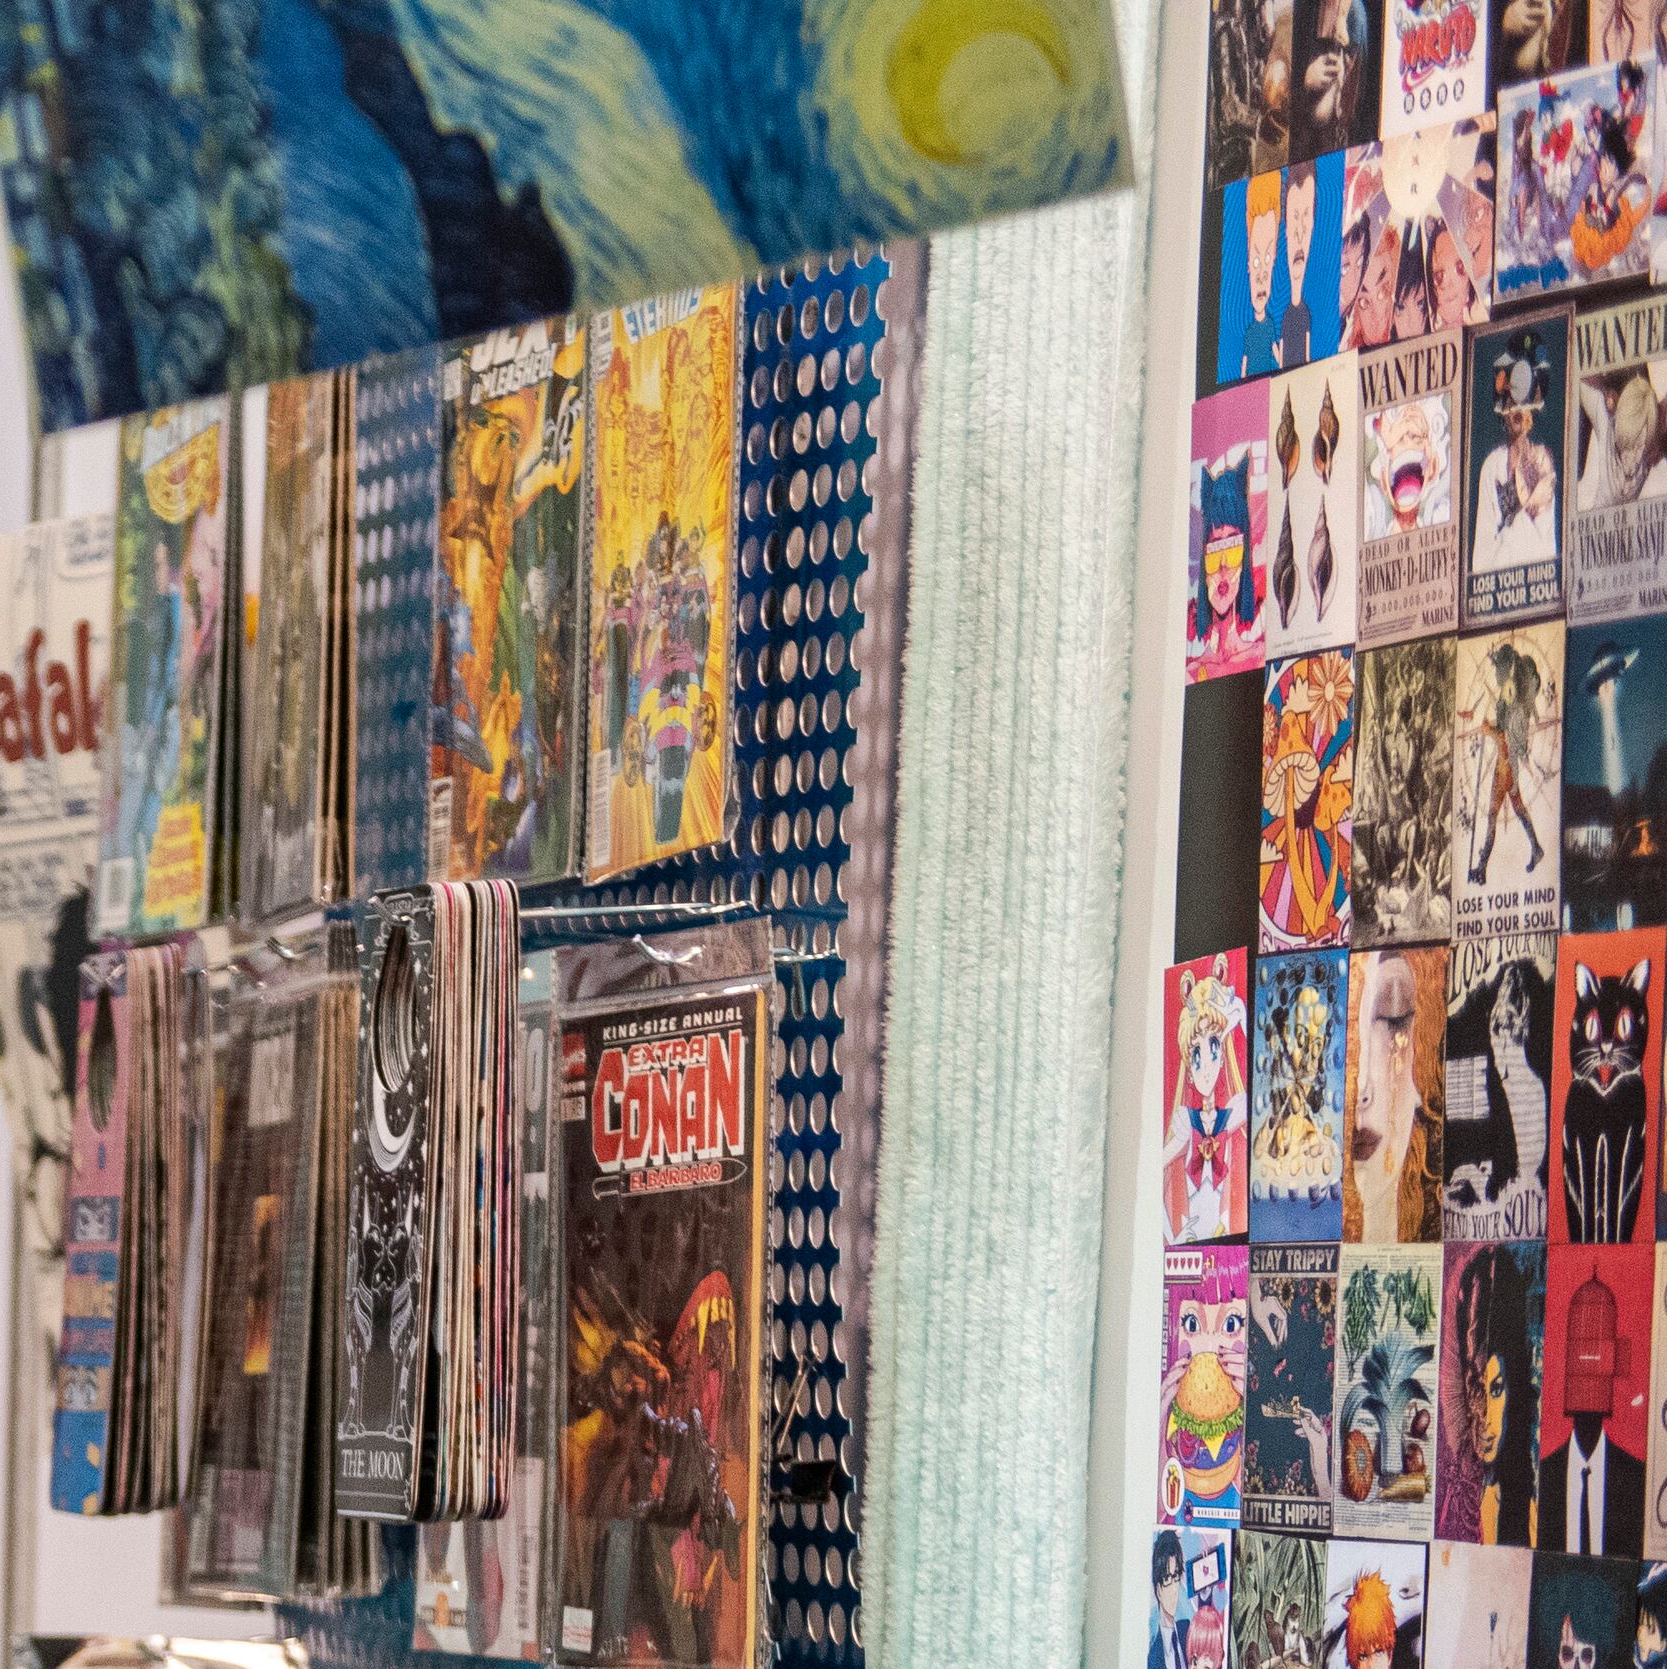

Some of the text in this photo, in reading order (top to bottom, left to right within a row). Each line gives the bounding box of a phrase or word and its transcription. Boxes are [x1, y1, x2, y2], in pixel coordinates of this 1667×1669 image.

[1576, 304, 1667, 371] WANTE
[1359, 342, 1458, 409] WANTED
[1365, 528, 1449, 562] DEAD OR ALIVE
[1473, 563, 1556, 595] LOSE YOUR MIND
[1468, 594, 1494, 612] FIND
[1498, 588, 1526, 607] YOUR
[1530, 581, 1558, 600] SOUL
[1421, 605, 1455, 626] MARINE
[1456, 887, 1556, 915] LOSE YOUR MIND
[1457, 911, 1556, 938] FIND YOUR SOUL
[682, 1006, 743, 1029] ANNUAL
[627, 1035, 708, 1074] EXTRA
[592, 1029, 746, 1174] CONAN
[629, 1173, 646, 1192] EL
[1472, 1211, 1501, 1240] YOUR
[1252, 1249, 1335, 1272] STAY TRIPPY
[341, 1449, 404, 1480] THE MOON
[1243, 1500, 1331, 1527] LITTLE HIPPIE
